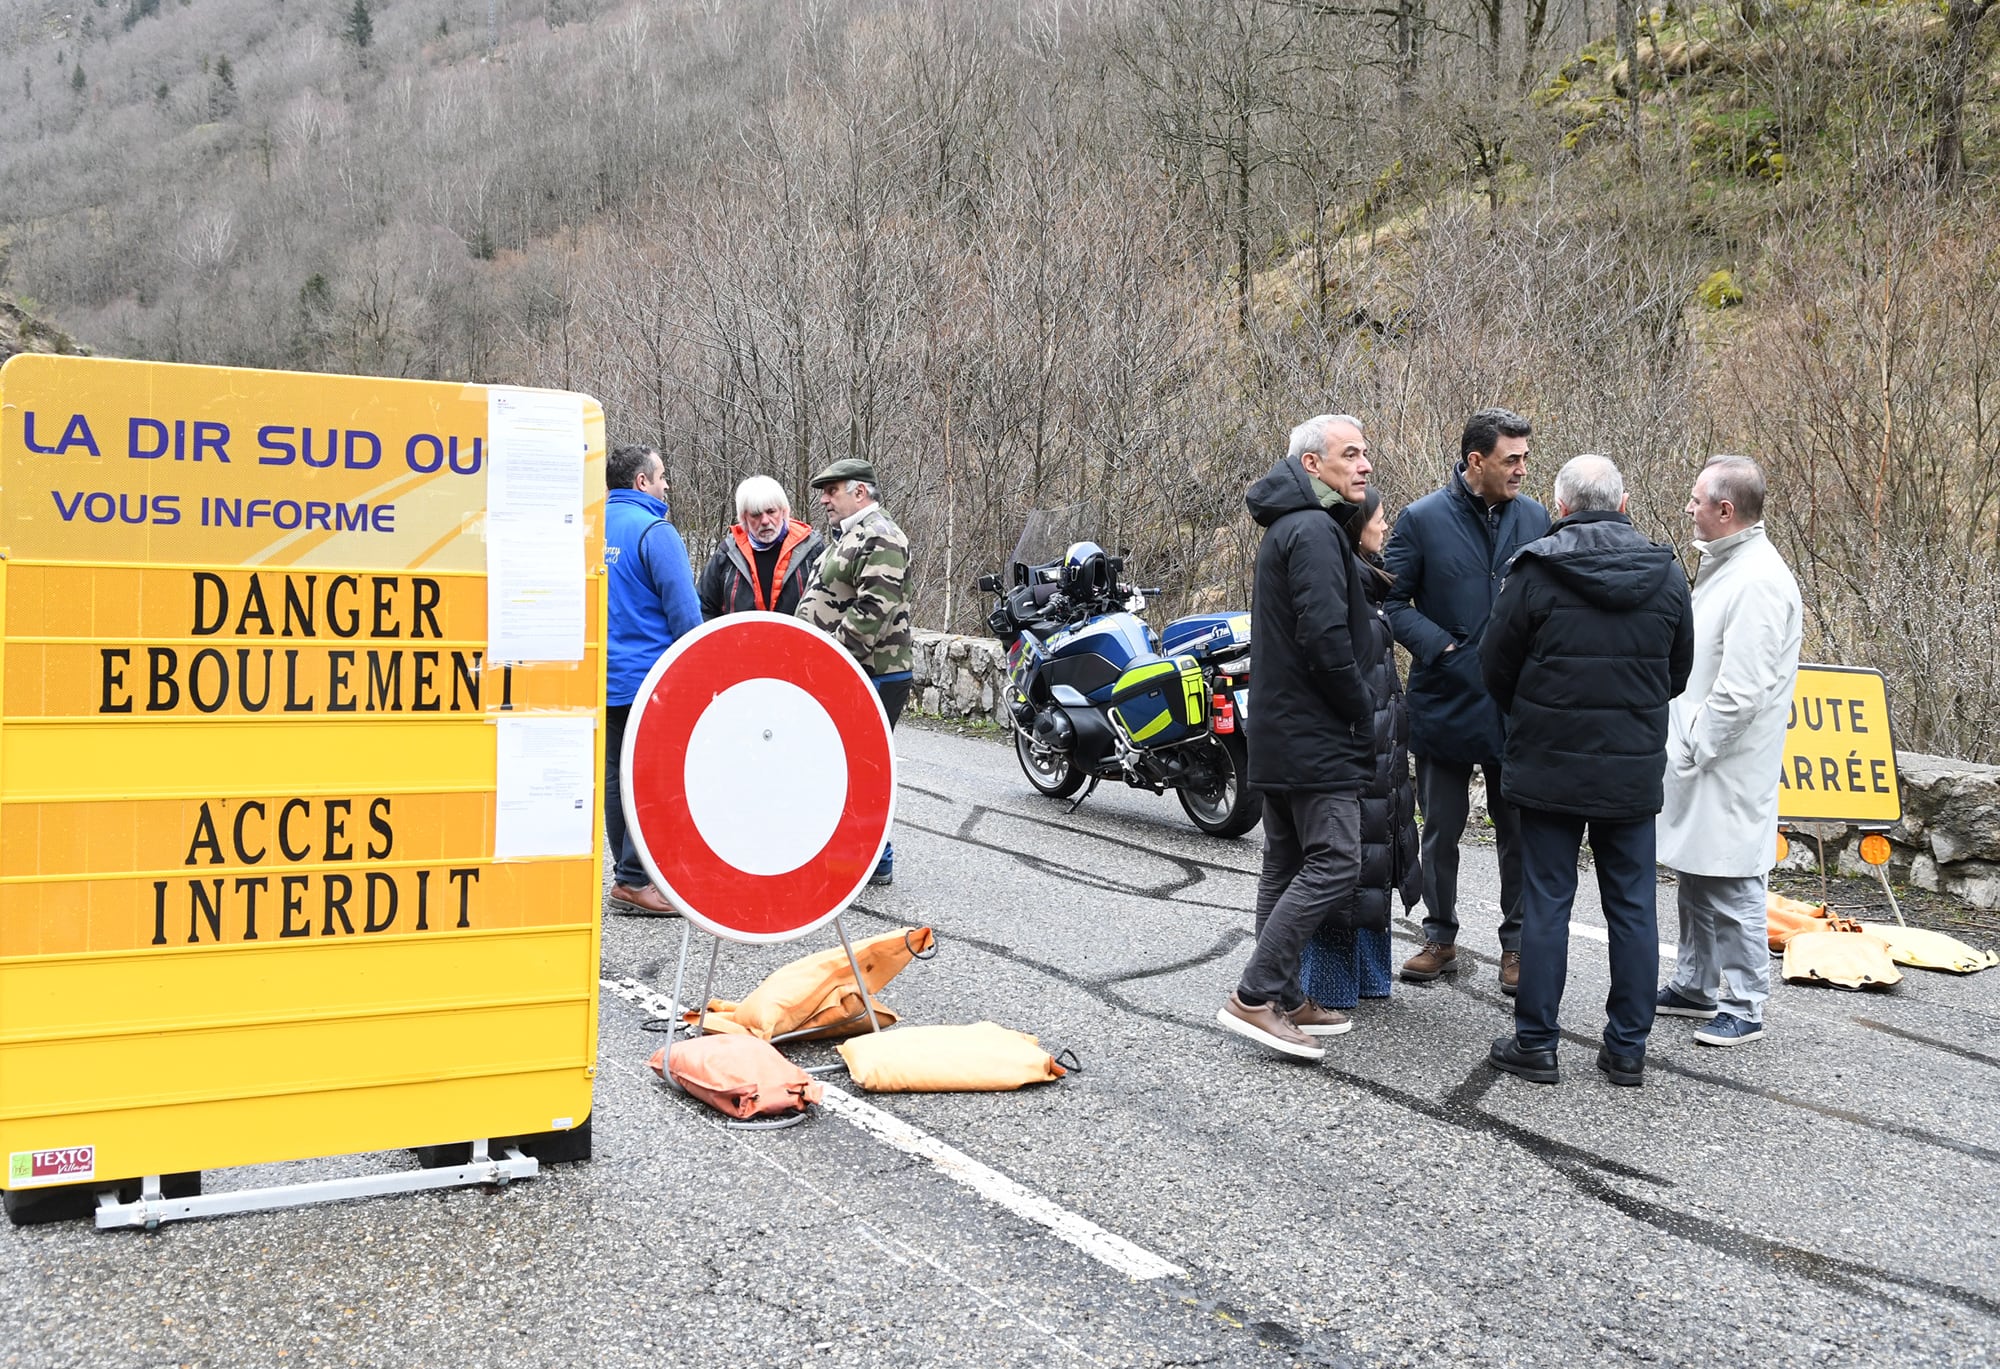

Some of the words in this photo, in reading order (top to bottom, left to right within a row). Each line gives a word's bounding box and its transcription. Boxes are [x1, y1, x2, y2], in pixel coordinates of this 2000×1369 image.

[24, 411, 100, 457] LA
[128, 417, 230, 463] DIR
[258, 425, 382, 470] SUD
[51, 491, 181, 525] VOUS
[201, 497, 395, 533] INFORME
[191, 572, 443, 638] DANGER
[1786, 695, 1869, 733] UTE
[1779, 750, 1890, 793] RRÉE
[184, 797, 393, 865] ACCES
[152, 868, 480, 945] INTERDIT
[33, 1148, 91, 1167] TEXTO
[57, 1162, 91, 1175] Village
